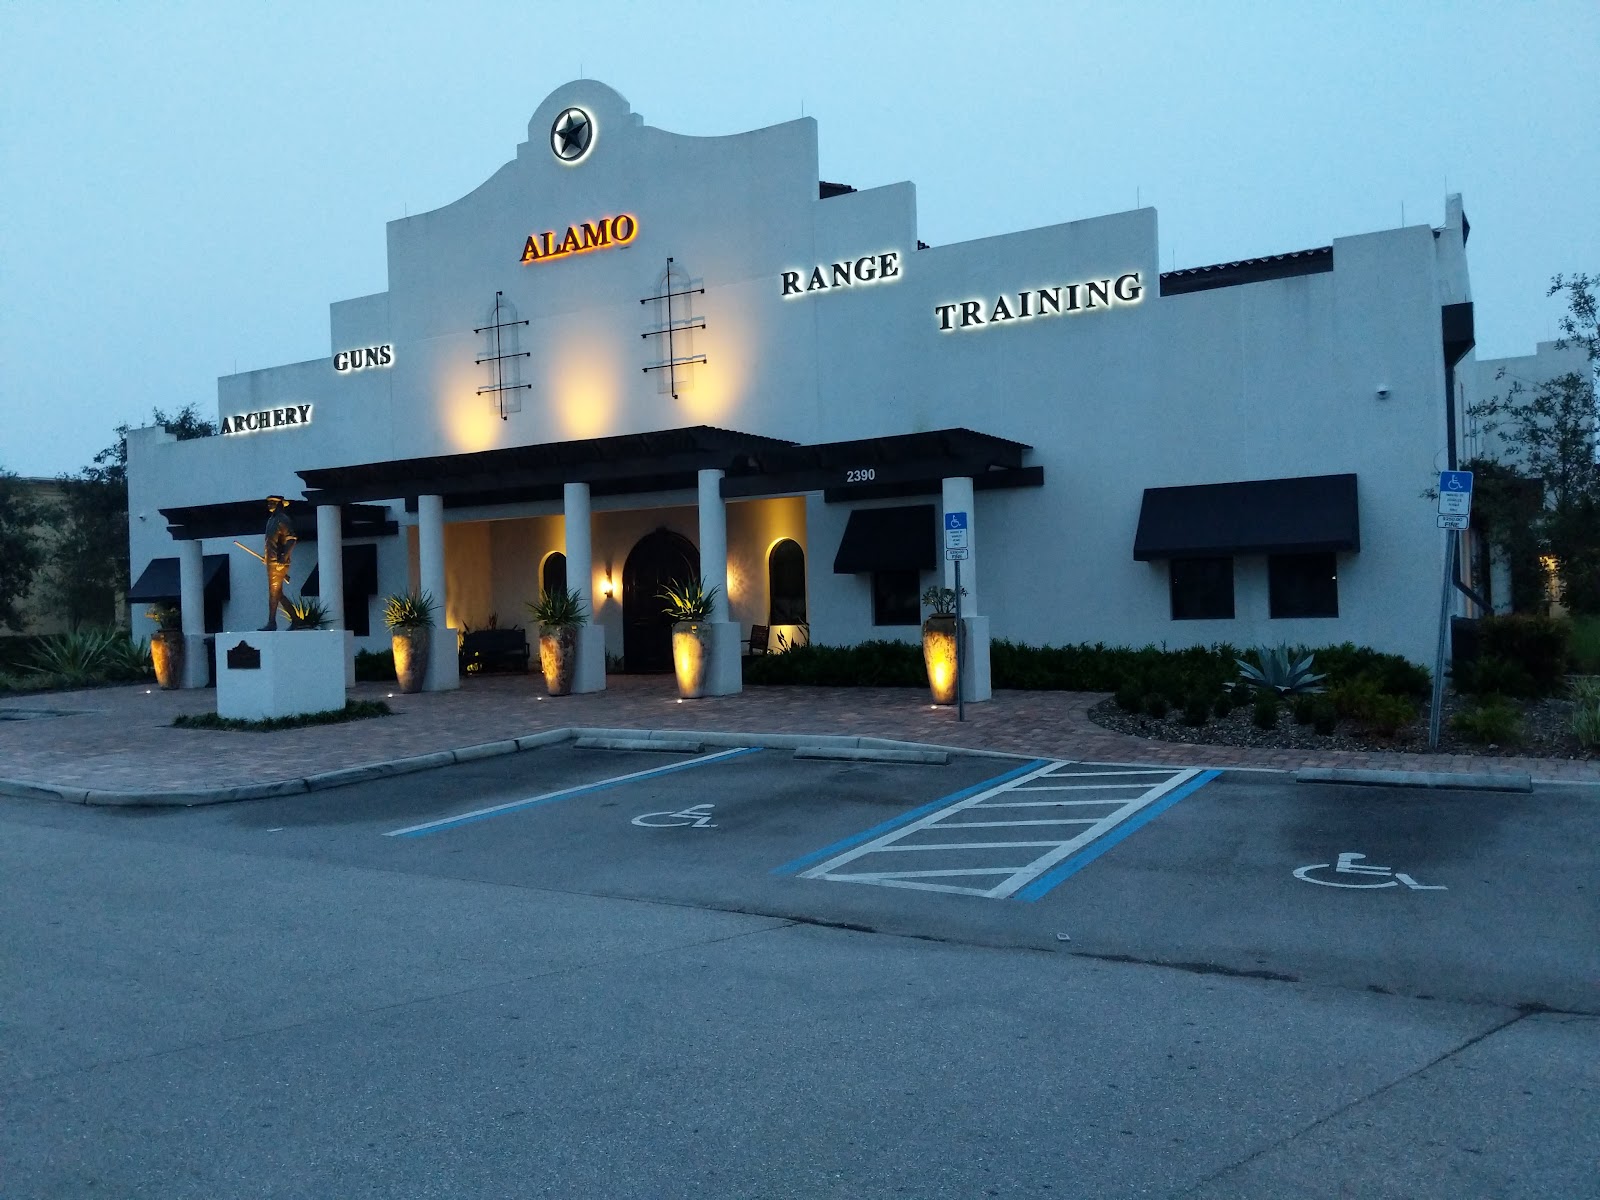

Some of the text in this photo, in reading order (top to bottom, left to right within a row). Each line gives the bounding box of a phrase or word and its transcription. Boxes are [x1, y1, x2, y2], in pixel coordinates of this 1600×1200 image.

[519, 214, 635, 262] ALAMO
[781, 251, 899, 297] RANGE
[935, 272, 1143, 331] TRAINING
[333, 344, 392, 371] GUNS
[219, 404, 312, 435] ARCHERY
[846, 468, 876, 483] 2390
